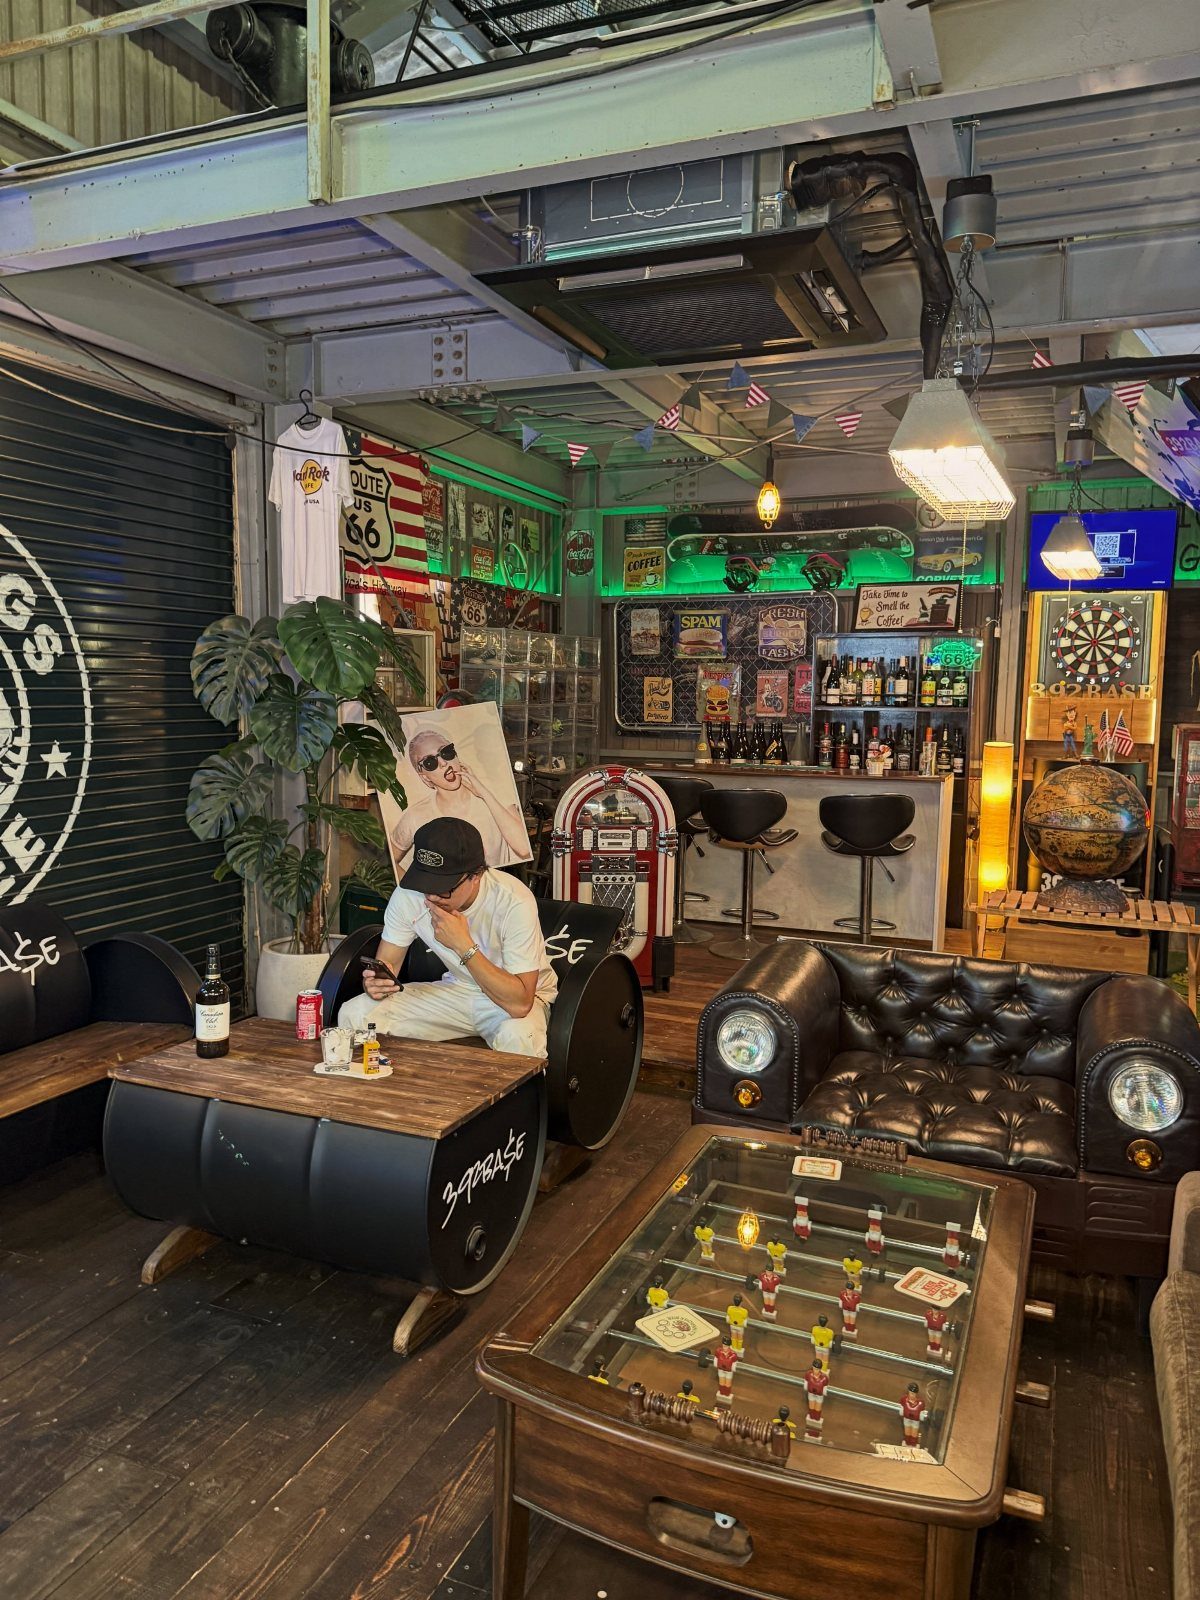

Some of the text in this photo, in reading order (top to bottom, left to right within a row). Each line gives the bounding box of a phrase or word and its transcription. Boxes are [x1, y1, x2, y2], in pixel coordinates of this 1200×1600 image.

[350, 469, 384, 496] OUTE
[353, 497, 373, 513] US
[345, 512, 381, 549] 66
[627, 555, 662, 573] COFFEE
[345, 576, 369, 591] ica's
[862, 589, 881, 601] Take
[883, 588, 900, 598] Time
[875, 601, 910, 612] Smell the
[467, 606, 481, 623] 66
[681, 615, 721, 628] SPAM
[876, 614, 904, 627] Coffee!
[944, 653, 962, 665] 66
[1030, 683, 1154, 699] 392BASE
